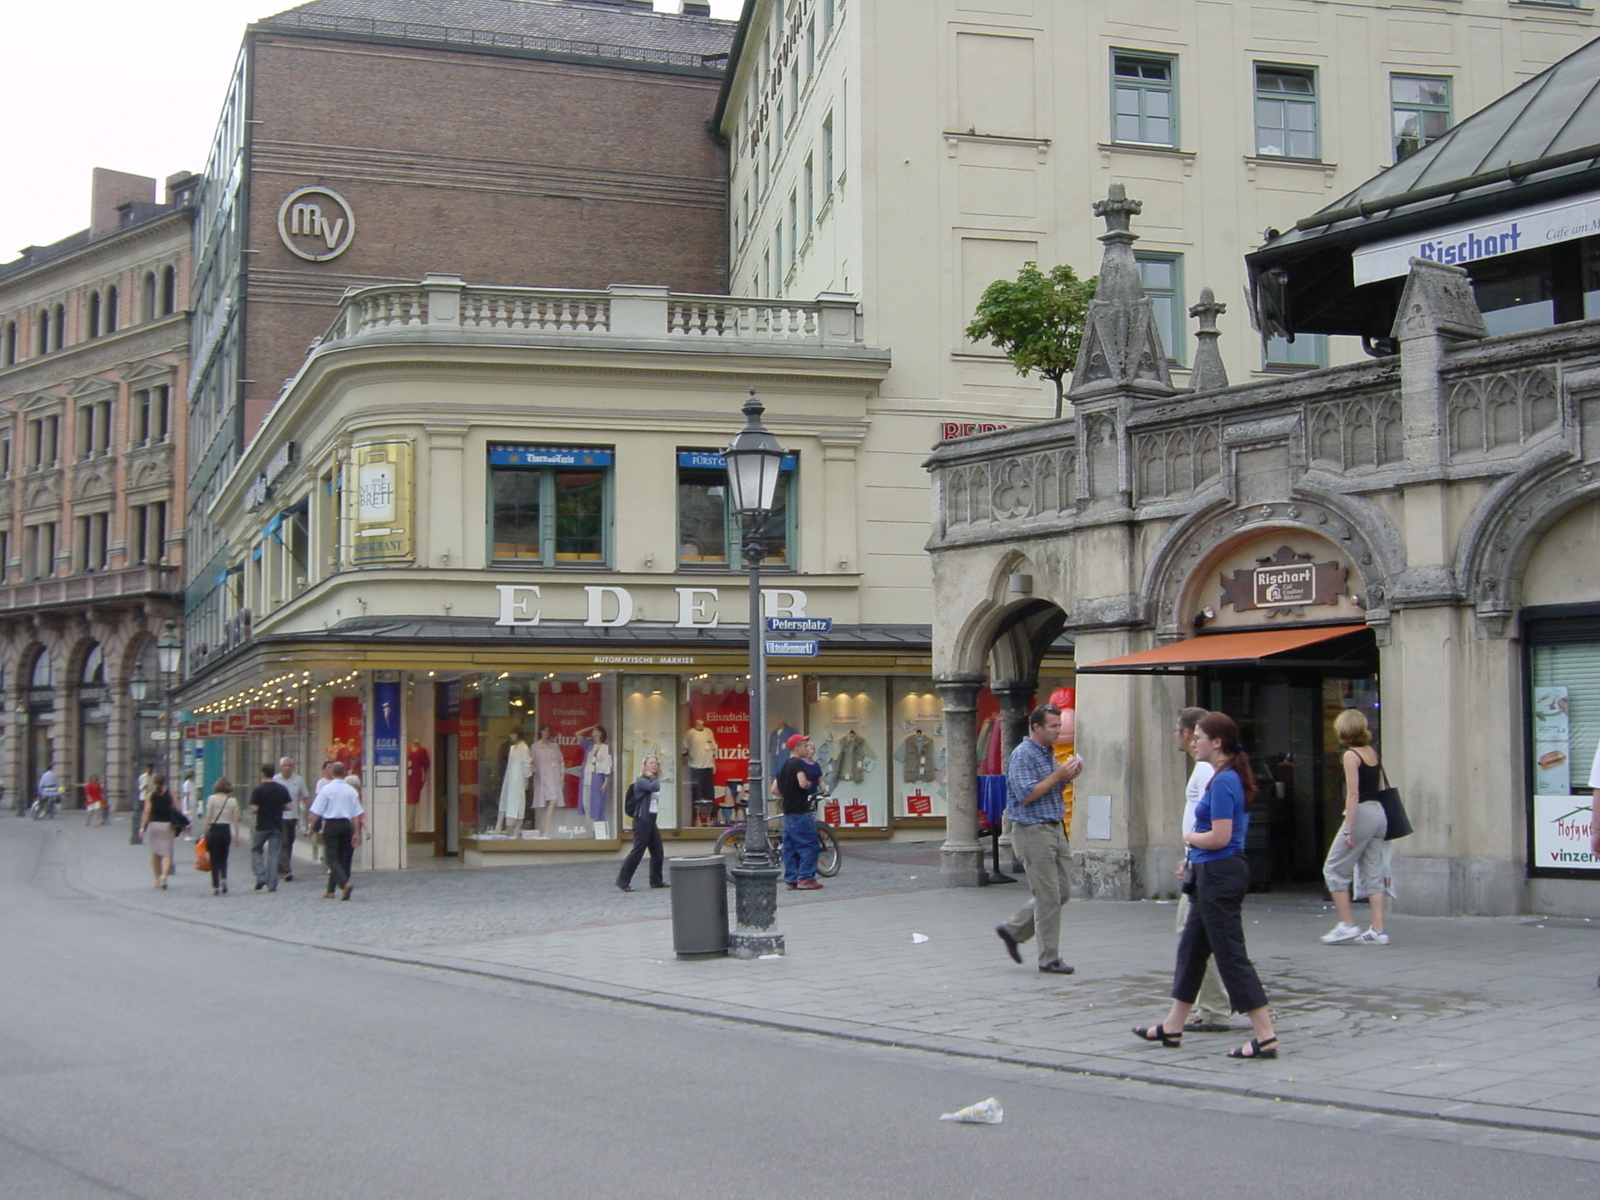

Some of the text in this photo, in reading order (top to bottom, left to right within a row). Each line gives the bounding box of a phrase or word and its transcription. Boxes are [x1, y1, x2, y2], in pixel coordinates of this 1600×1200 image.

[1571, 224, 1588, 235] am
[1420, 223, 1522, 265] Rischart
[692, 456, 717, 465] FÜRST
[360, 492, 391, 508] BRETT
[1258, 570, 1310, 585] Rischart
[772, 618, 827, 631] Petersplatz
[594, 656, 653, 664] AUTOMATISCHE
[717, 724, 738, 733] stark
[1551, 848, 1600, 863] vinzen
